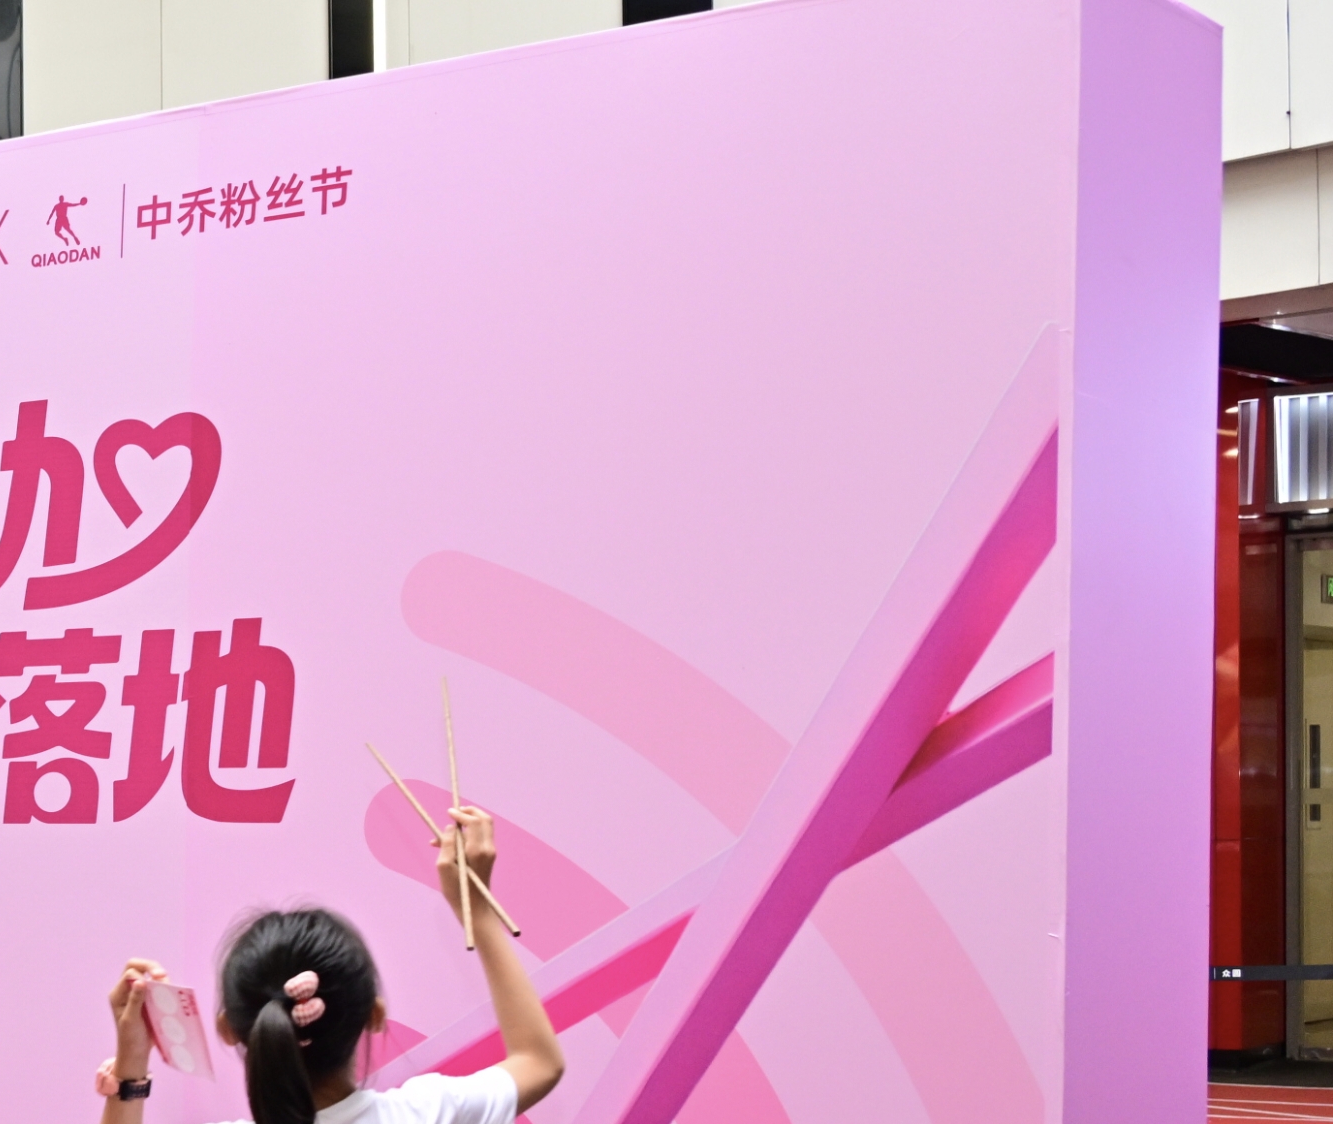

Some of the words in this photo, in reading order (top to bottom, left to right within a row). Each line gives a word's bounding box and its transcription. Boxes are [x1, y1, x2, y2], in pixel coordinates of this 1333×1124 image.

[136, 165, 353, 241] 中乔粉丝节
[31, 245, 101, 268] QIAODAN
